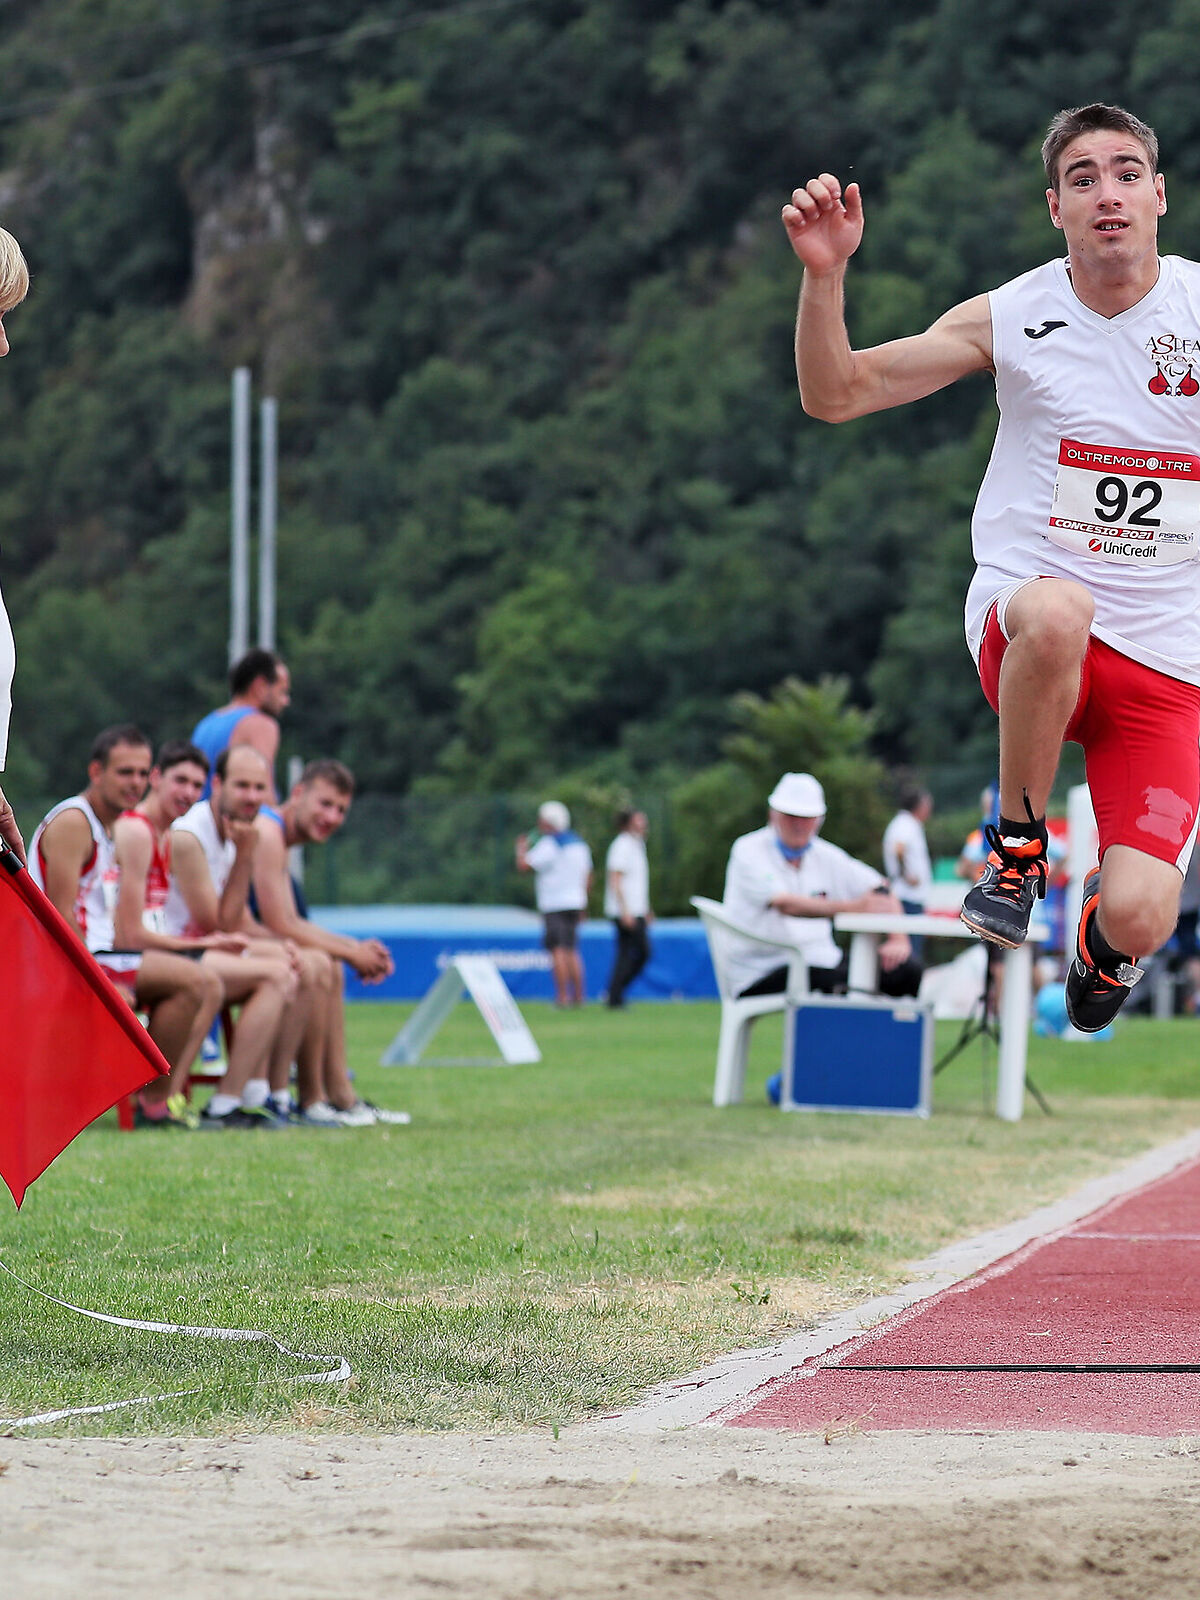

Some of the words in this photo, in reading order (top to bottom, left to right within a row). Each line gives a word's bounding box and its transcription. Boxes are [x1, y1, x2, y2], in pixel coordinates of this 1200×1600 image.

[1094, 476, 1163, 527] 92
[1055, 518, 1118, 537] CONCESIO
[1119, 530, 1153, 540] 2021
[1103, 541, 1158, 558] UniCredit
